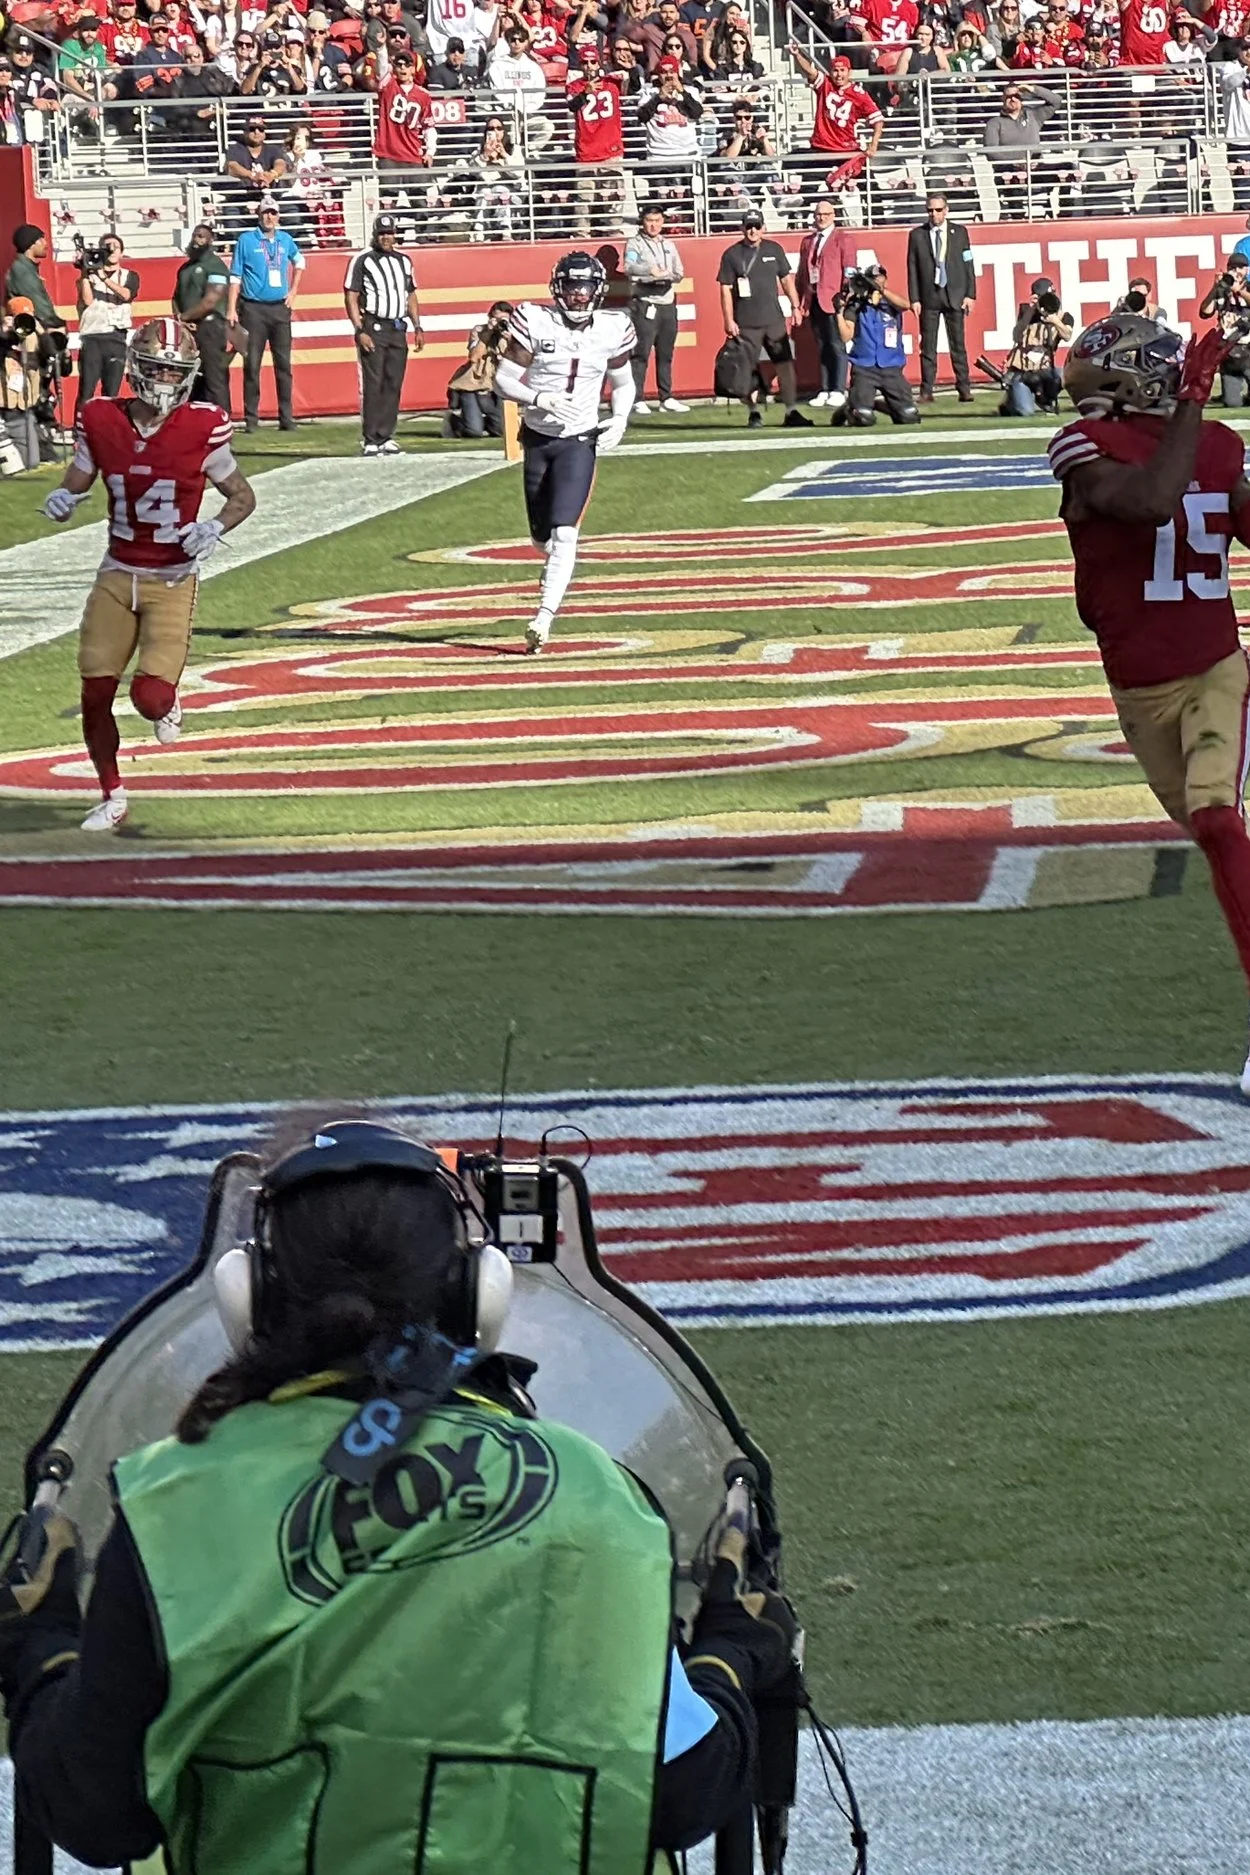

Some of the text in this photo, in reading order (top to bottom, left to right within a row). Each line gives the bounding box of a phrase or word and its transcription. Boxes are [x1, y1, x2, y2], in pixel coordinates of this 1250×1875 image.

[881, 17, 908, 42] 54
[582, 91, 614, 121] 23
[565, 357, 580, 397] 1
[107, 474, 181, 544] 14
[1143, 492, 1230, 601] 15
[331, 1433, 487, 1557] FOX
